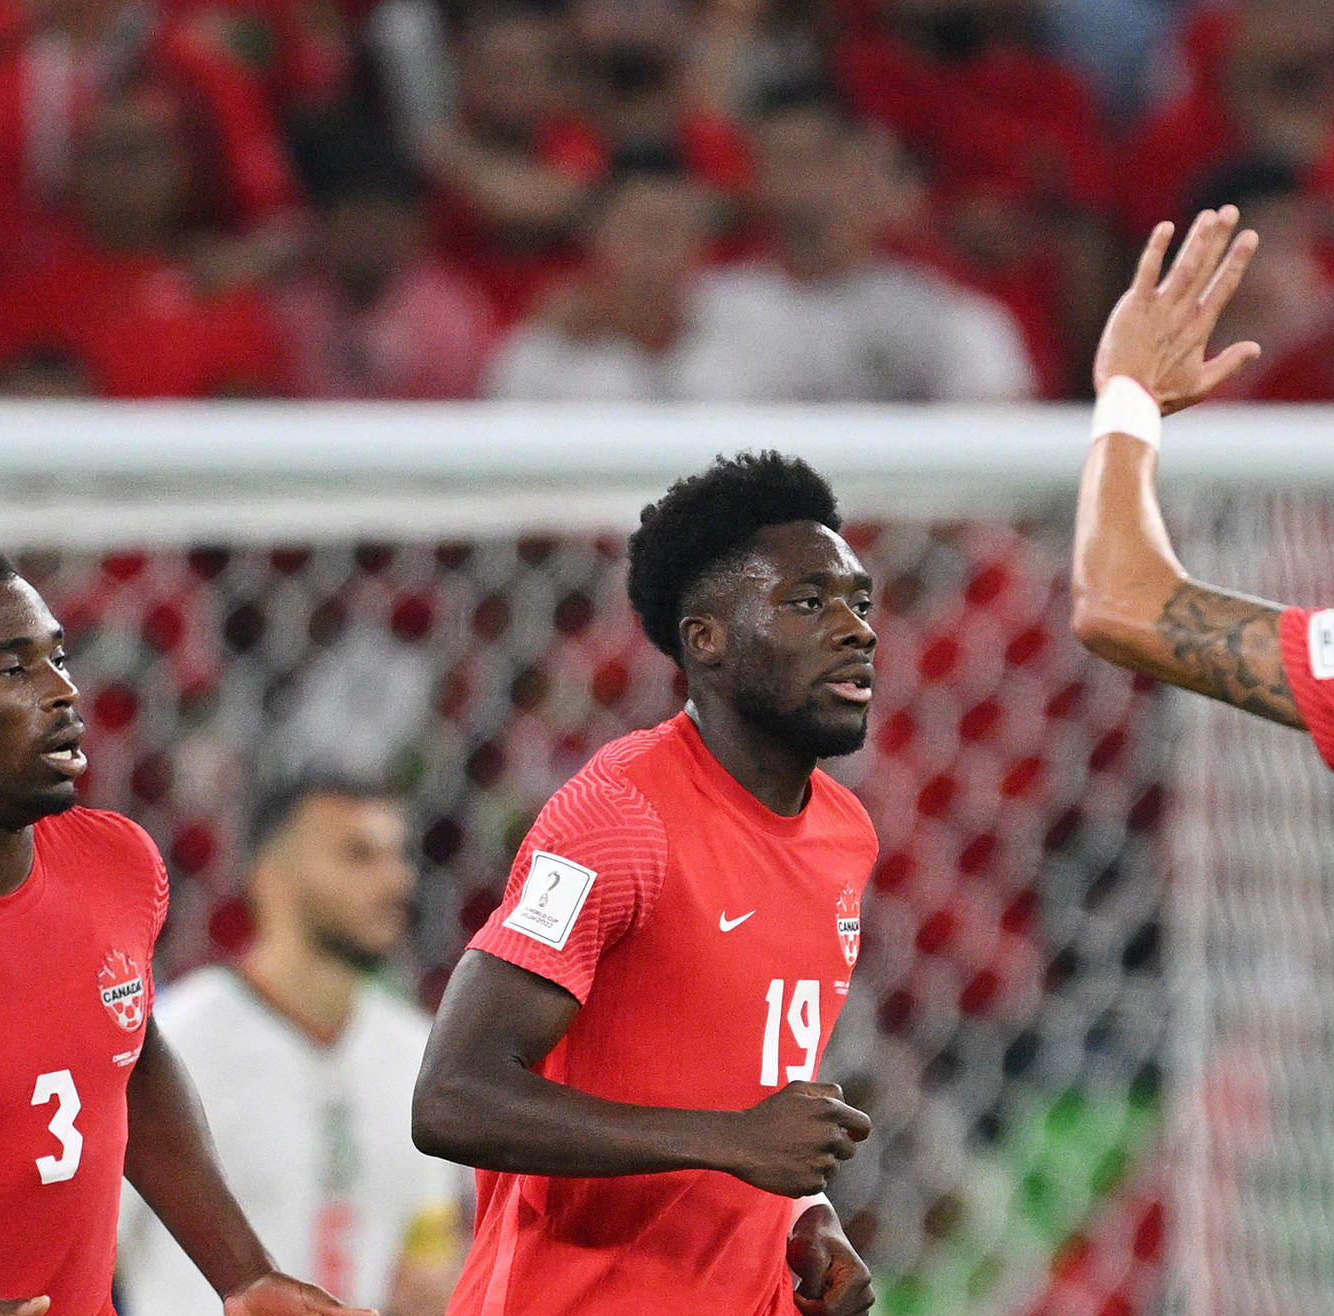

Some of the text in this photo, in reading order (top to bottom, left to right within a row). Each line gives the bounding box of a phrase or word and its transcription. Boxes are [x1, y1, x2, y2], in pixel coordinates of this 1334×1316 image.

[103, 981, 142, 1003] CANADA
[760, 979, 821, 1087] 19
[31, 1069, 83, 1185] 3
